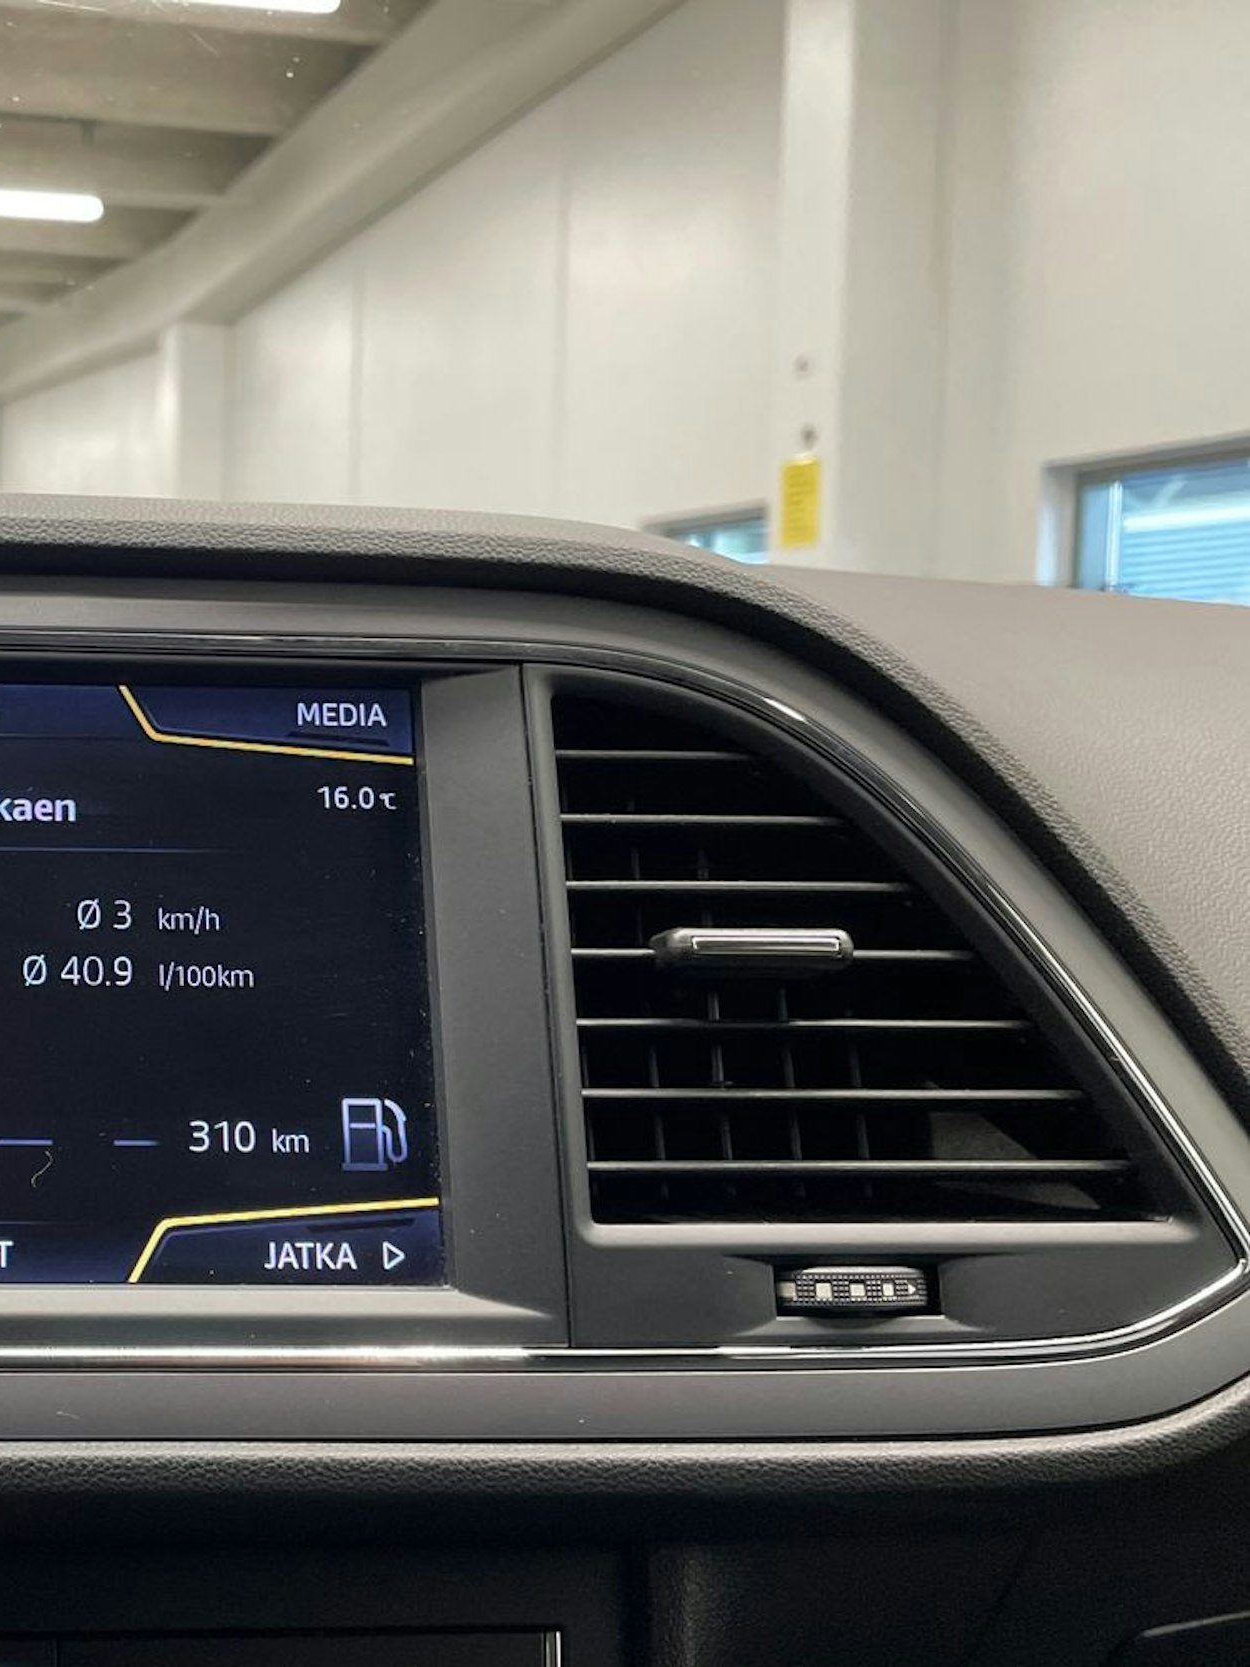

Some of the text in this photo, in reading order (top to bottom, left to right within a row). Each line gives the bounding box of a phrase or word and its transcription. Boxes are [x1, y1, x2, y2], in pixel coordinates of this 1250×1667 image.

[297, 702, 388, 727] MEDIA
[113, 899, 133, 930] 3
[158, 905, 221, 935] km/h
[60, 955, 133, 987] 40.9
[159, 961, 254, 991] l/100km
[189, 1120, 310, 1153] 310 km
[264, 1241, 358, 1270] JATKA
